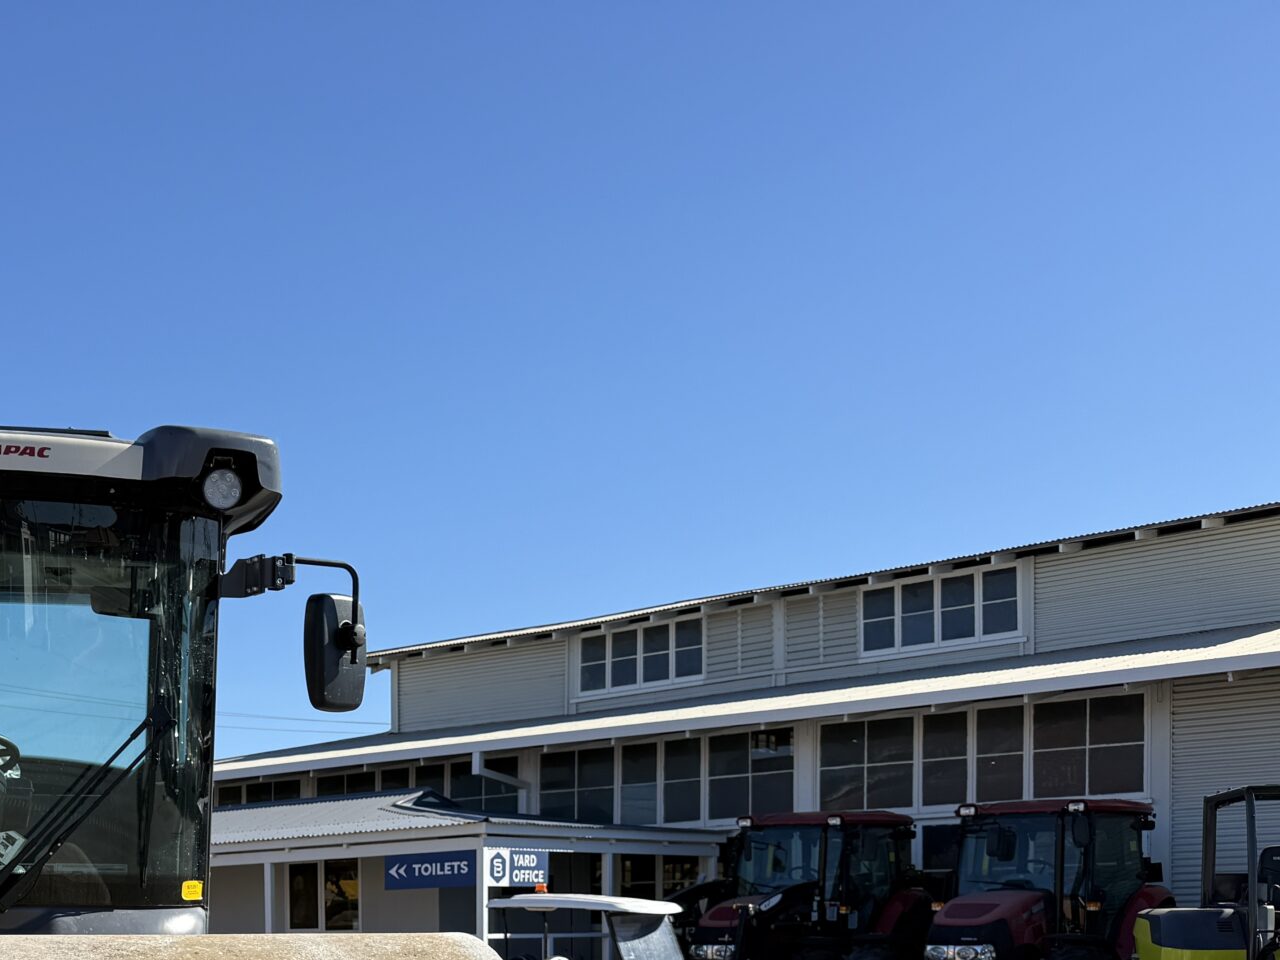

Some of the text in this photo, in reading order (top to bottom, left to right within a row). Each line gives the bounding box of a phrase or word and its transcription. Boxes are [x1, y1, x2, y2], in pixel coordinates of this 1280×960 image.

[512, 854, 537, 867] YARD
[412, 861, 469, 877] TOILETS
[512, 869, 544, 883] OFFICE
